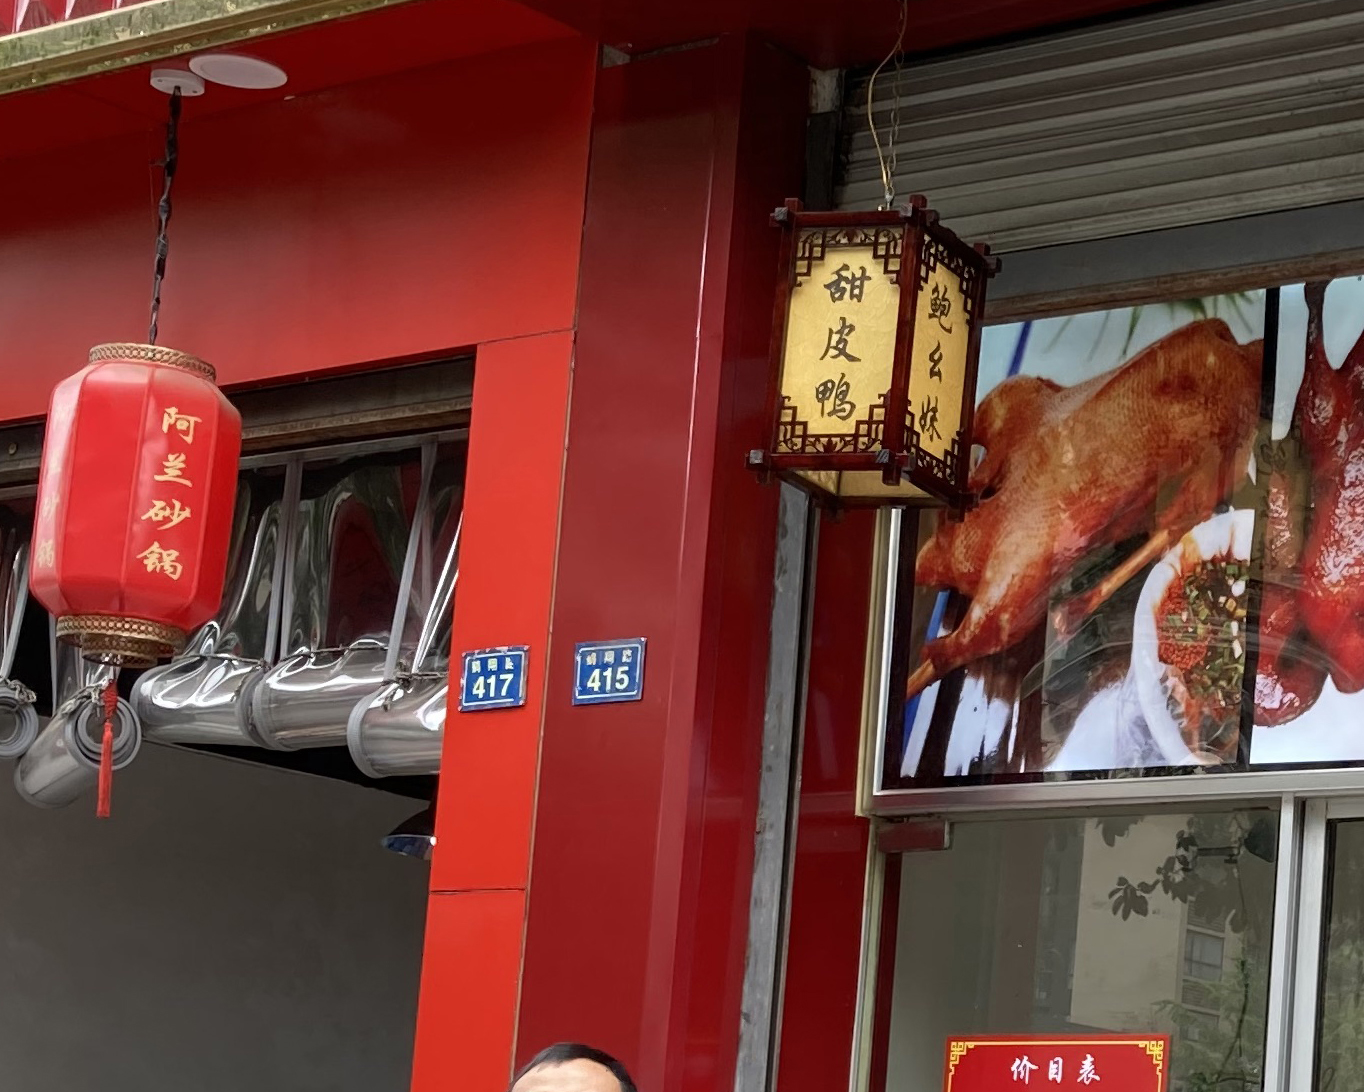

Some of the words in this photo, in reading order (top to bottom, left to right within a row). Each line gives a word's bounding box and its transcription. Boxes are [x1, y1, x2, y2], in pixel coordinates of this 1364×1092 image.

[815, 262, 872, 421] 甜皮鸭
[919, 281, 953, 443] 鲍幺妹
[136, 406, 202, 581] 阿兰砂锅
[472, 673, 514, 699] 417
[586, 666, 630, 693] 415
[1010, 1053, 1101, 1086] 价目表
